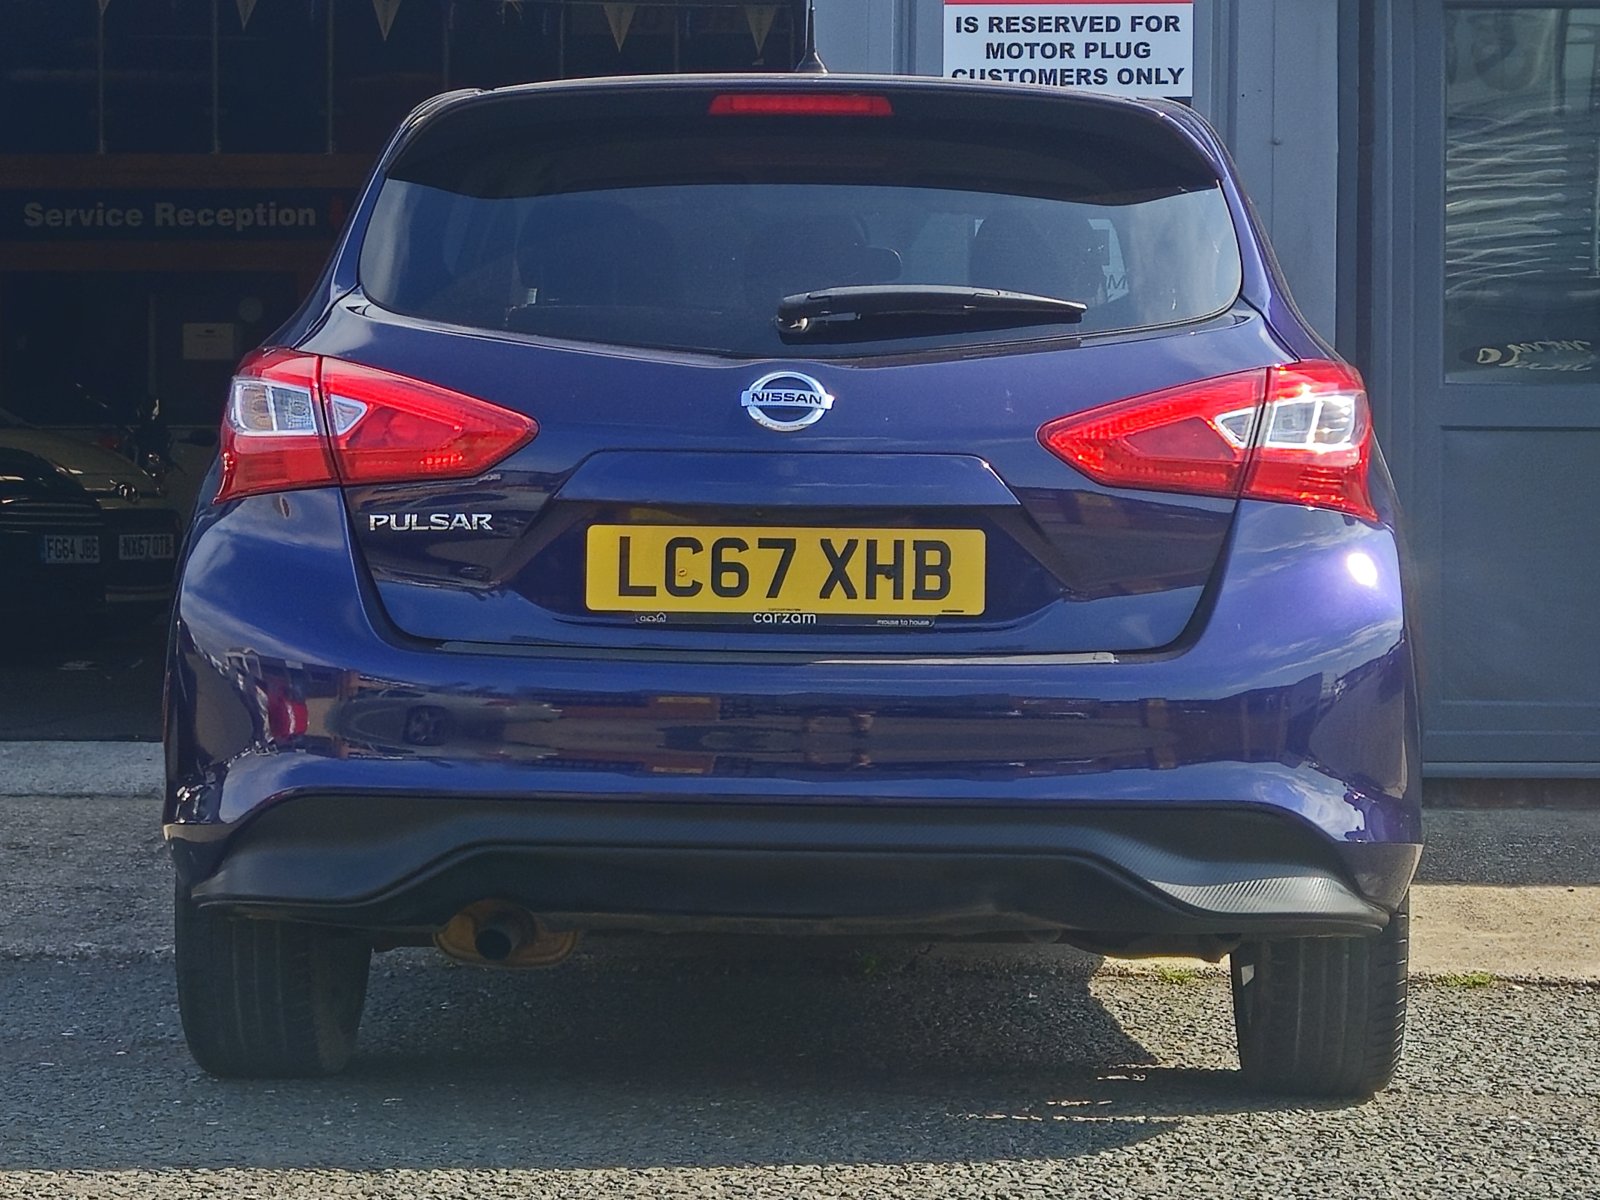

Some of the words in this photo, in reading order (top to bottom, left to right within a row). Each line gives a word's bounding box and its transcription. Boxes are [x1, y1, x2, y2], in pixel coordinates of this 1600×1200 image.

[955, 16, 979, 33] IS
[988, 16, 1121, 33] RESERVED
[1130, 15, 1181, 33] FOR
[985, 42, 1076, 60] MOTOR
[1084, 41, 1151, 59] PLUG
[1117, 67, 1185, 85] ONLY
[23, 202, 144, 227] Service
[154, 202, 317, 232] Reception
[751, 392, 822, 406] NISSAN
[369, 513, 493, 531] PULSAR
[618, 535, 797, 599] LC67
[819, 538, 952, 600] XHB
[752, 611, 817, 625] carzam
